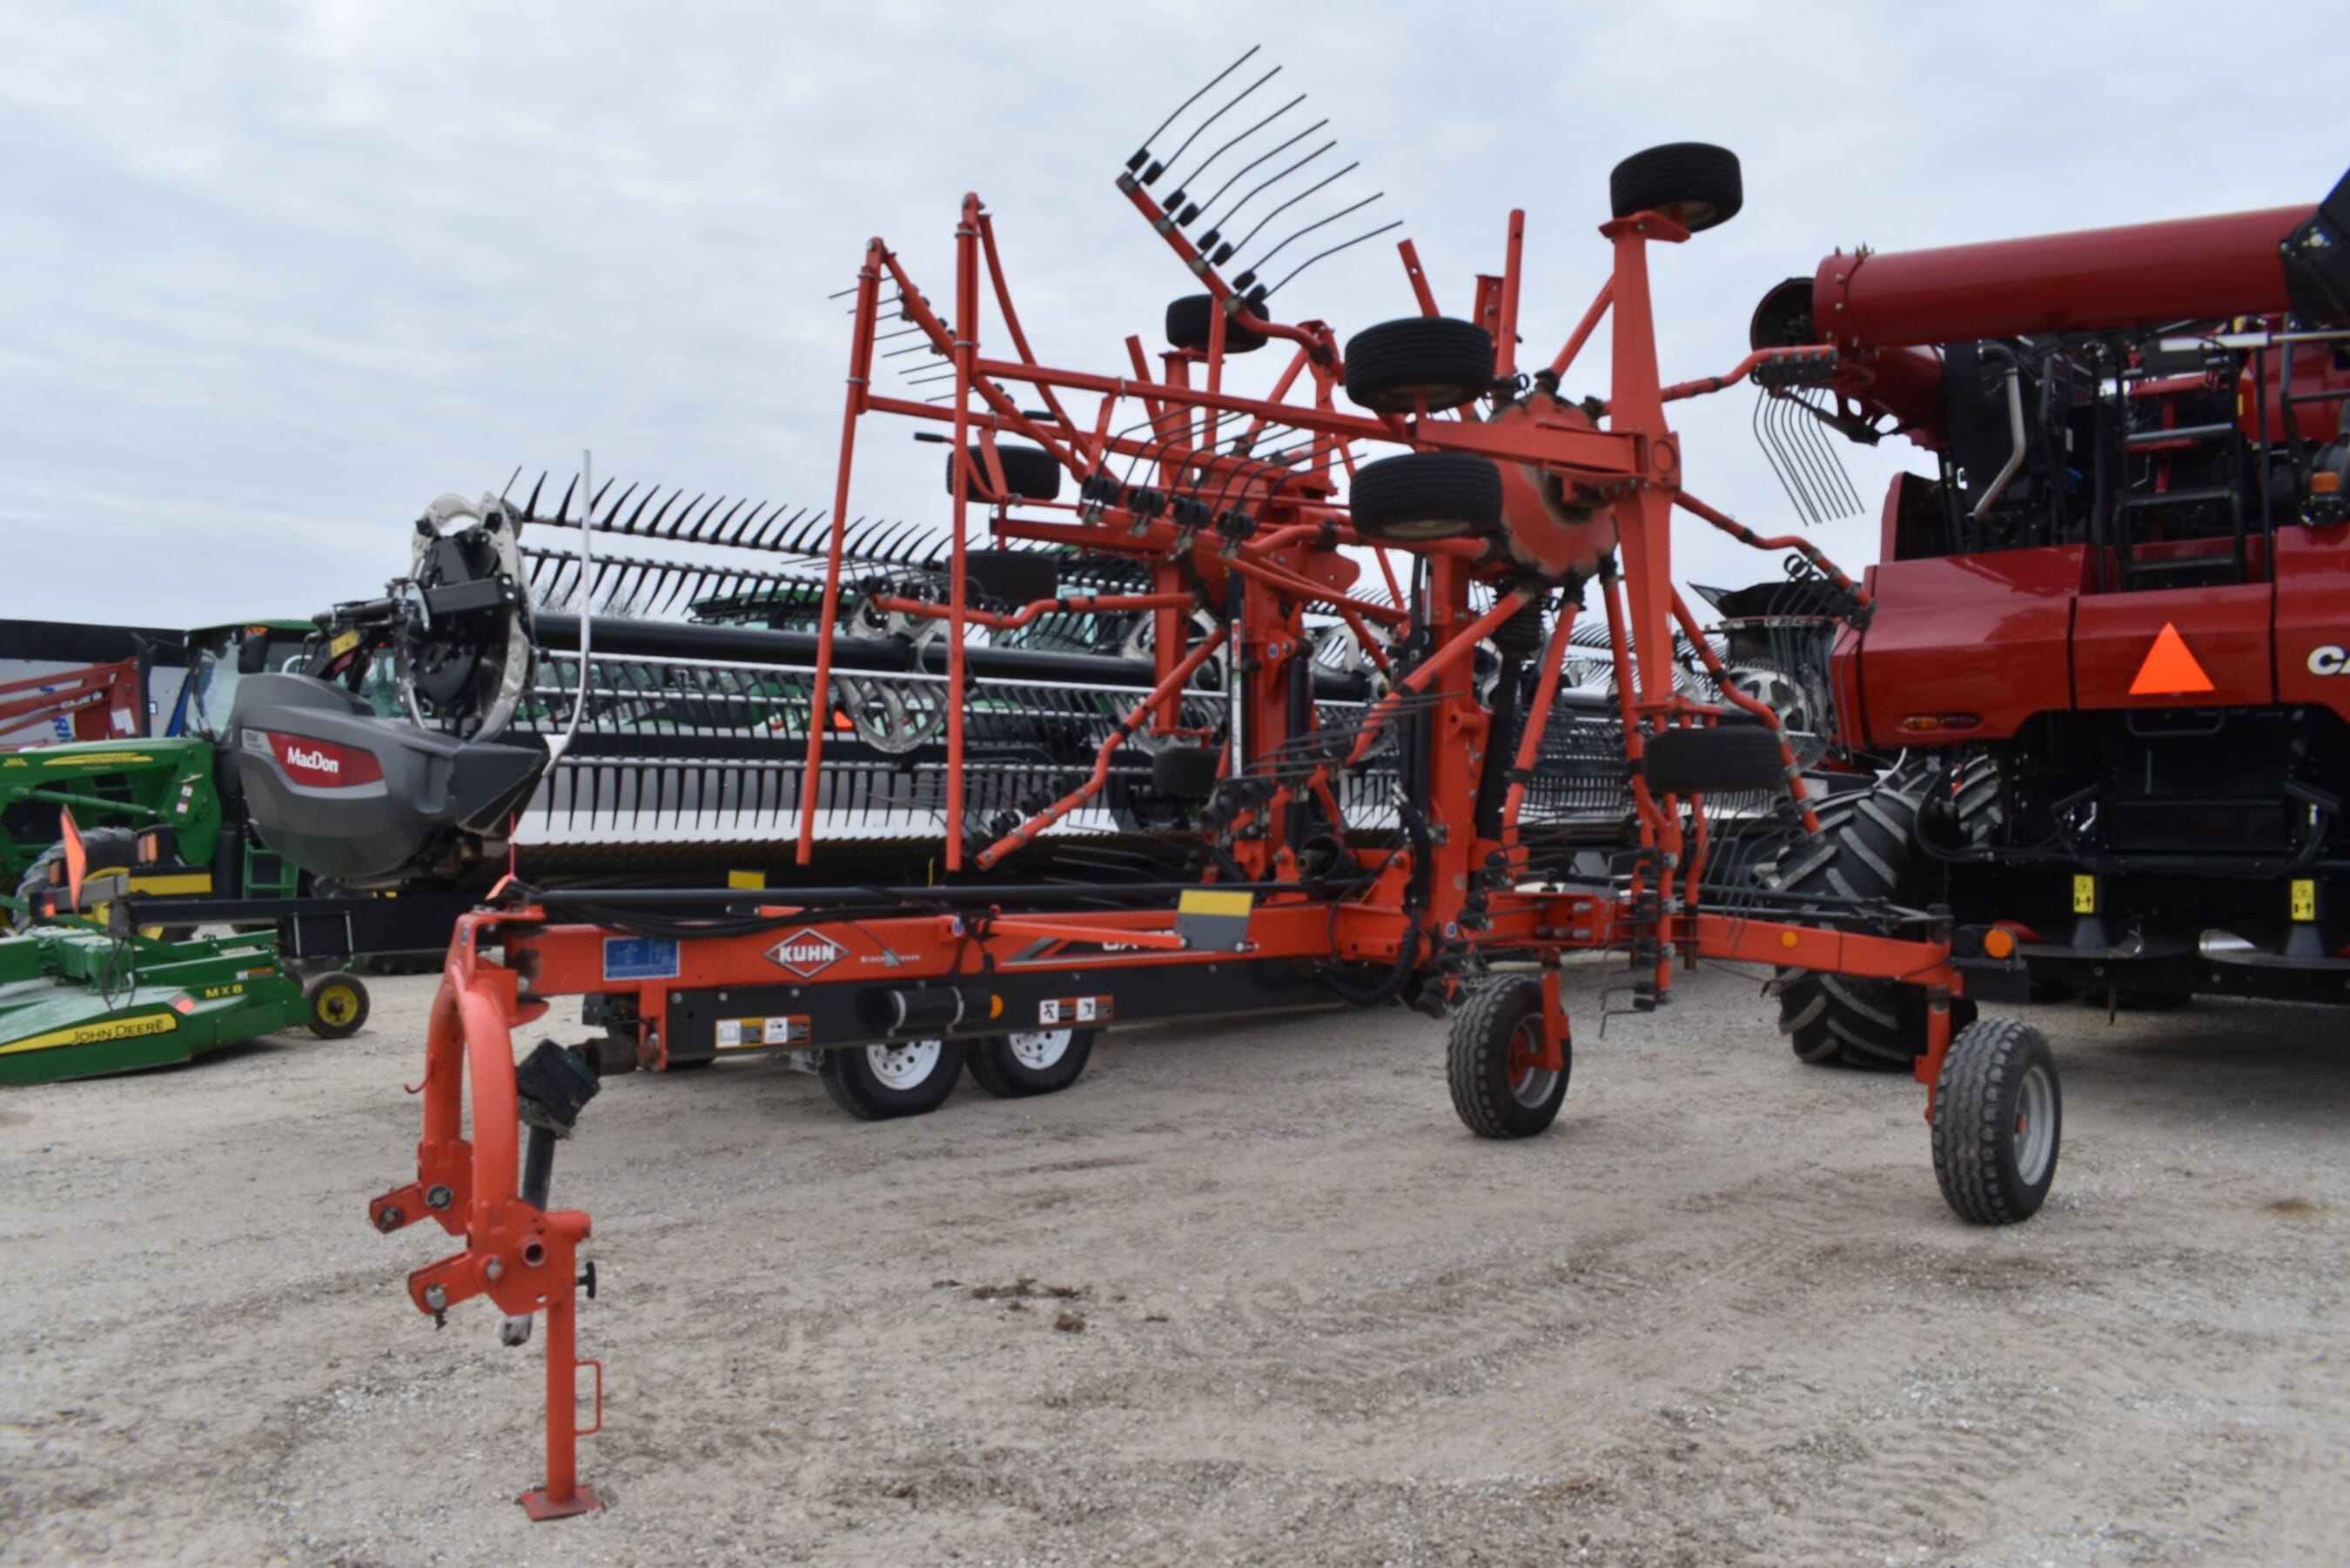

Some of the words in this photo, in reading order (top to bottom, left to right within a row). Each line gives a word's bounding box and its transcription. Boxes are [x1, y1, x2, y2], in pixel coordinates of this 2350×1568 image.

[286, 746, 339, 774] MacDon
[778, 944, 836, 963] KUHN
[71, 1028, 112, 1043] JOHN
[115, 1018, 165, 1038] DEERE
